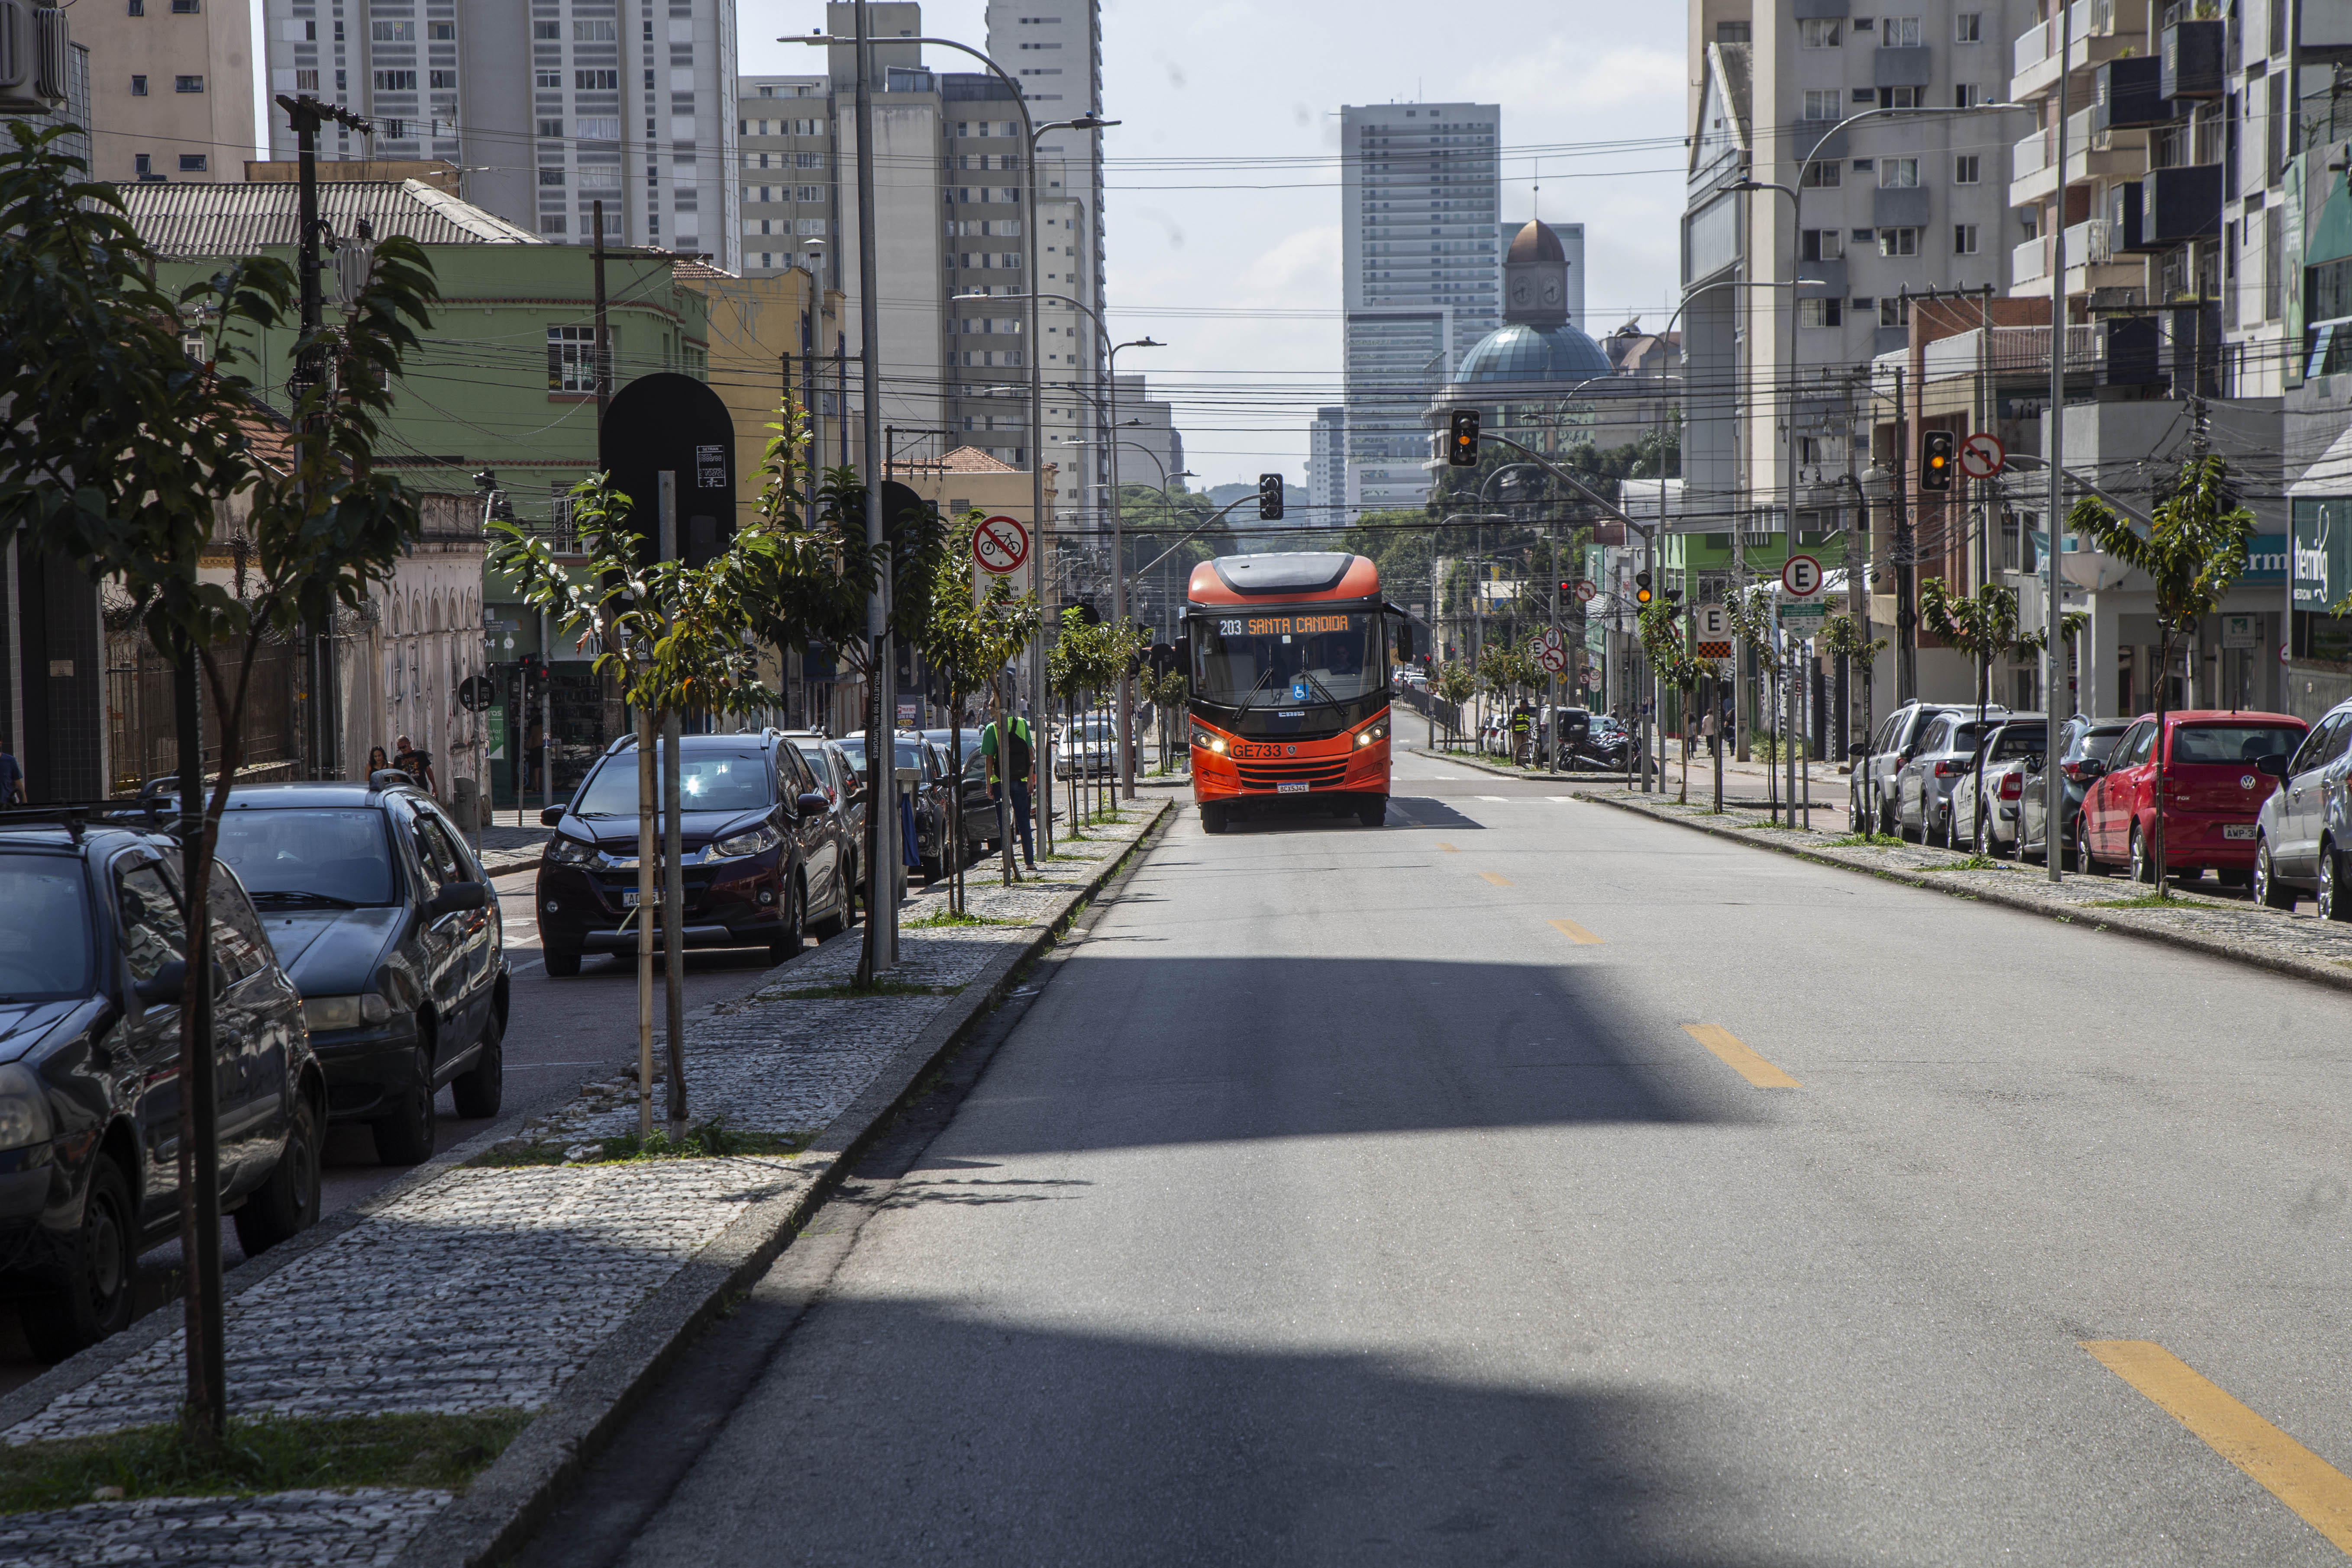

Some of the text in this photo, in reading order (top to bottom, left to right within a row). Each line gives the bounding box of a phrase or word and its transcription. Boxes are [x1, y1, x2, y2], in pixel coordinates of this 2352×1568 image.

[2295, 504, 2329, 603] fleming
[1795, 564, 1809, 587] E
[1220, 615, 1348, 635] 203 SANTA CANDIDA
[1708, 611, 1721, 631] E
[1533, 643, 1541, 654] E
[1233, 745, 1282, 757] GE733
